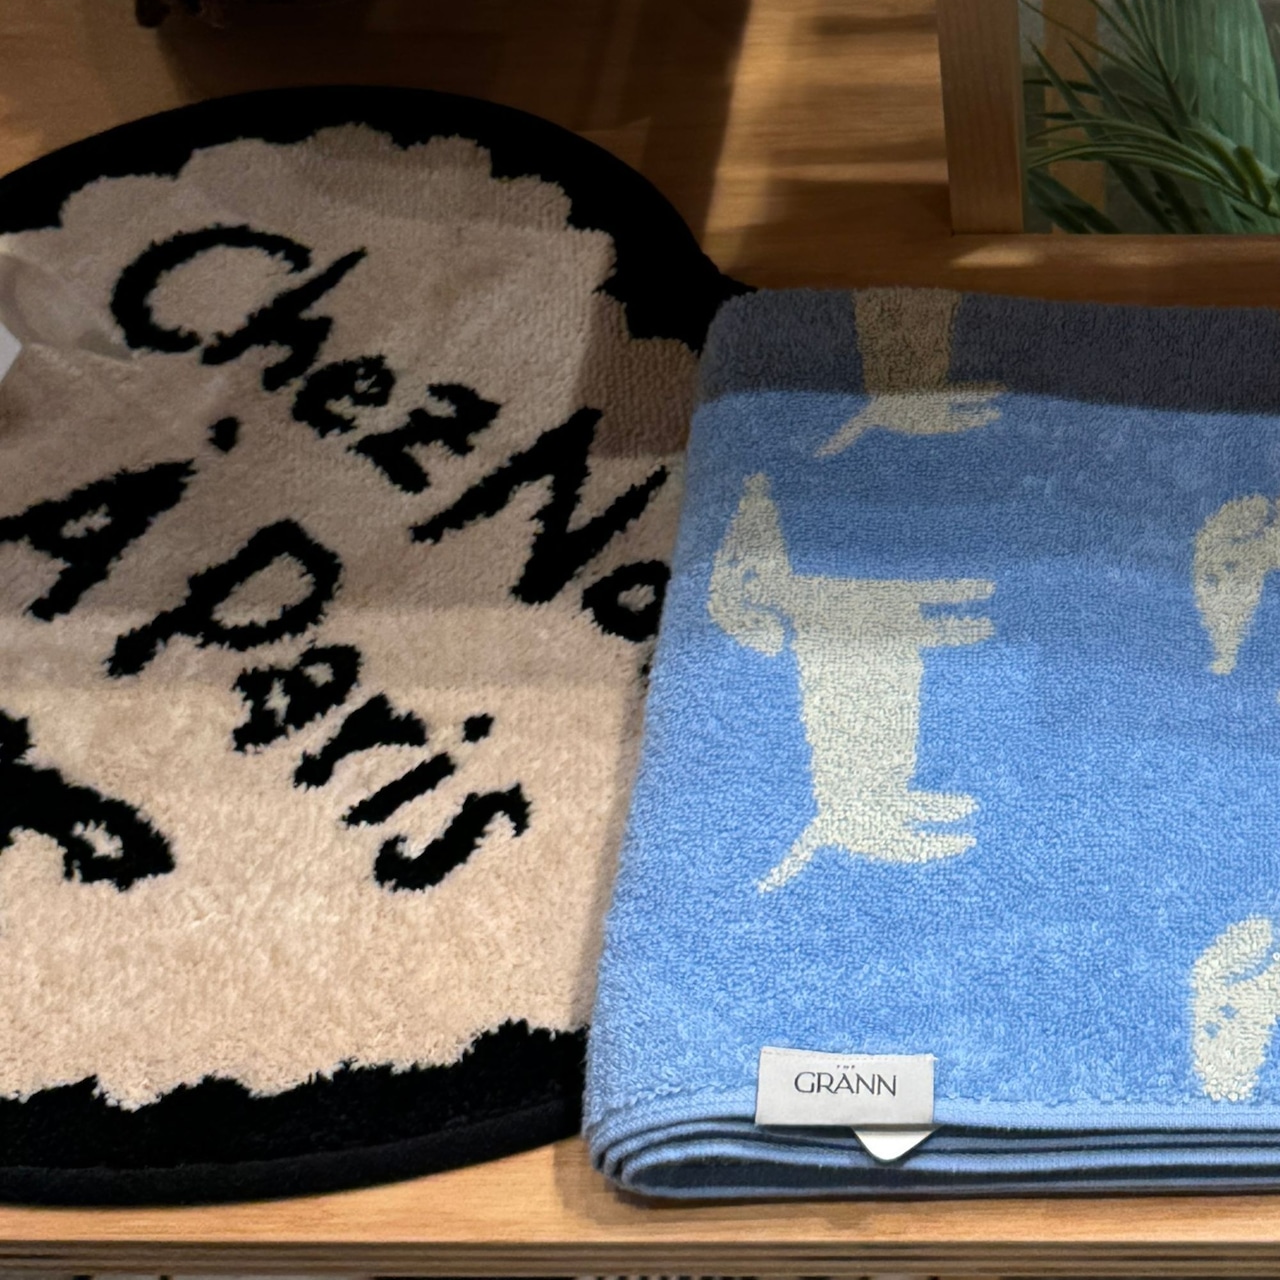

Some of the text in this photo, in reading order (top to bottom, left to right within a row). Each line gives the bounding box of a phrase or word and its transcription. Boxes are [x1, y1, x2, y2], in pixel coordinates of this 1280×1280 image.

[410, 408, 672, 675] No
[105, 520, 532, 892] Paris
[793, 1071, 897, 1097] GRANN
